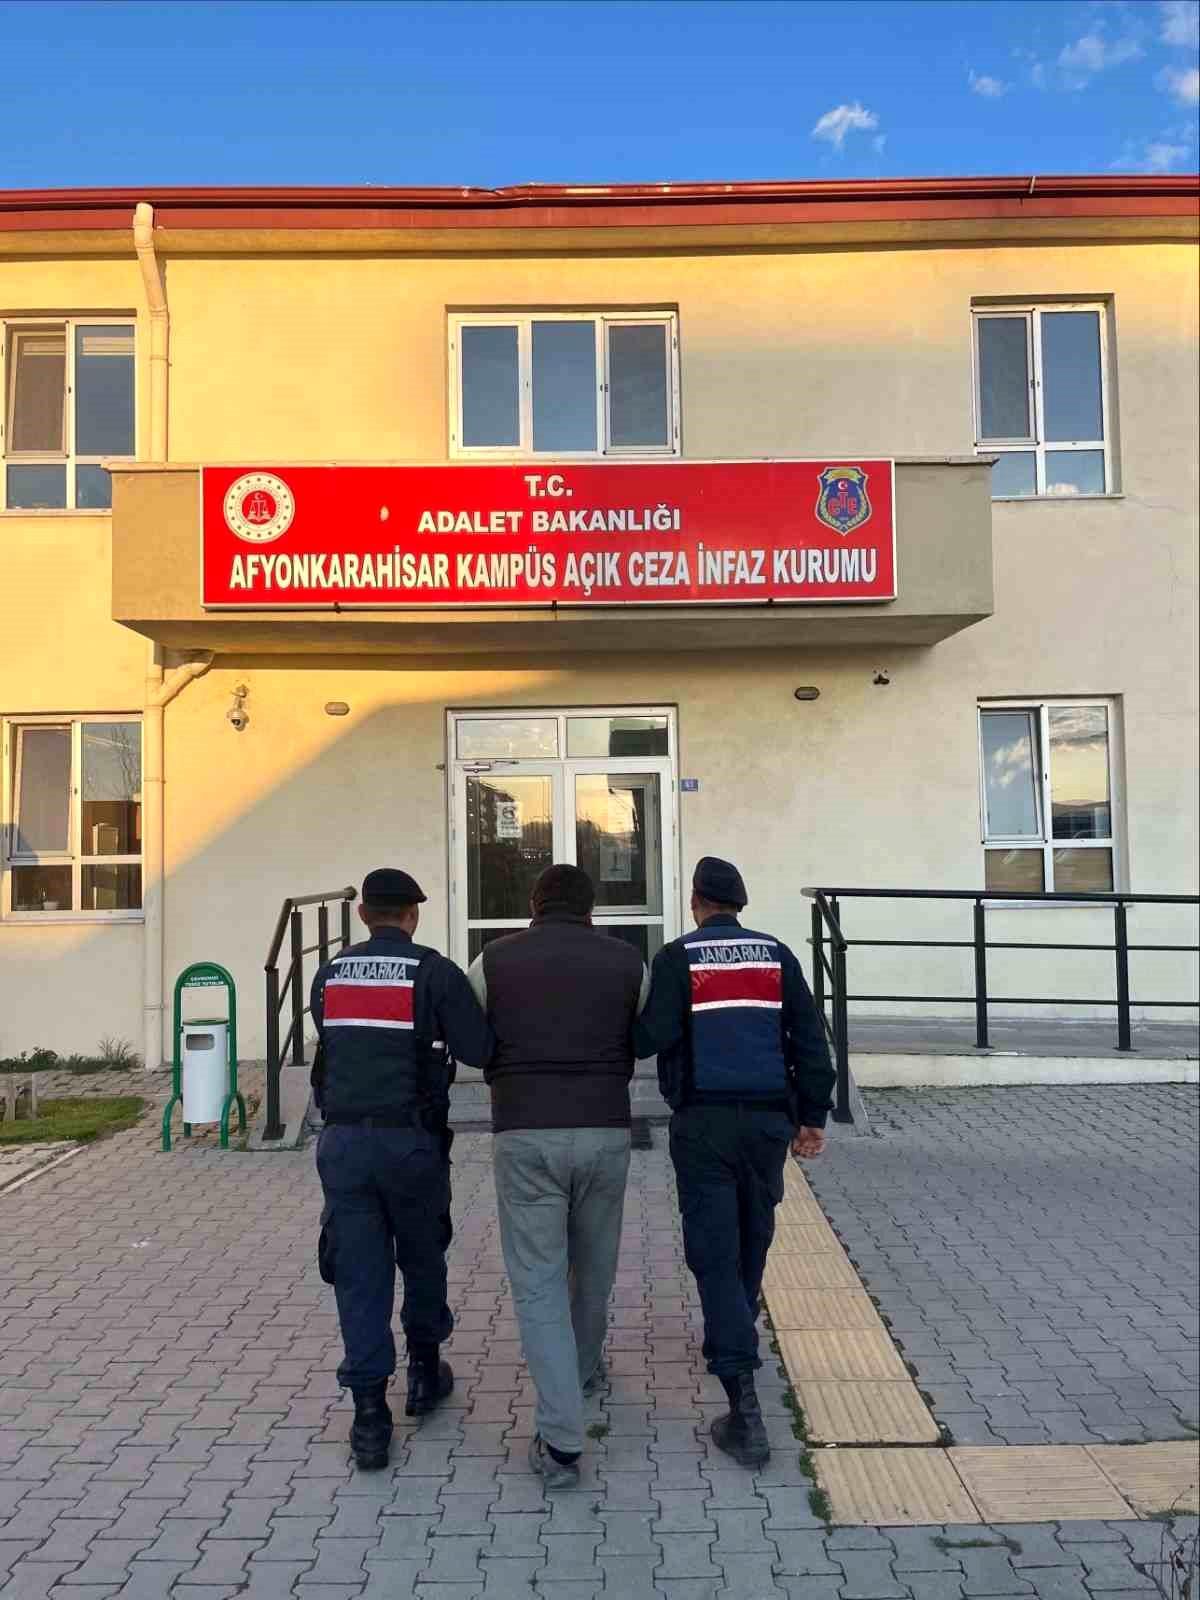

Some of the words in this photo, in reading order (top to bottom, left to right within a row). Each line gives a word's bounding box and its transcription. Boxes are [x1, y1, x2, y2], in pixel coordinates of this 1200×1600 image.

[525, 475, 573, 497] T.C.
[418, 511, 522, 532] ADALET
[532, 504, 680, 532] BAKANLIĞI
[230, 545, 450, 589] AFYONKARAHİSAR
[457, 545, 556, 588] KAMPÜS
[563, 552, 621, 595] AÇIK
[628, 552, 690, 586] CEZA
[698, 542, 766, 585] İNFAZ
[772, 548, 877, 584] KURUMU
[699, 946, 772, 963] JANDARMA
[334, 962, 407, 980] JANDARMA
